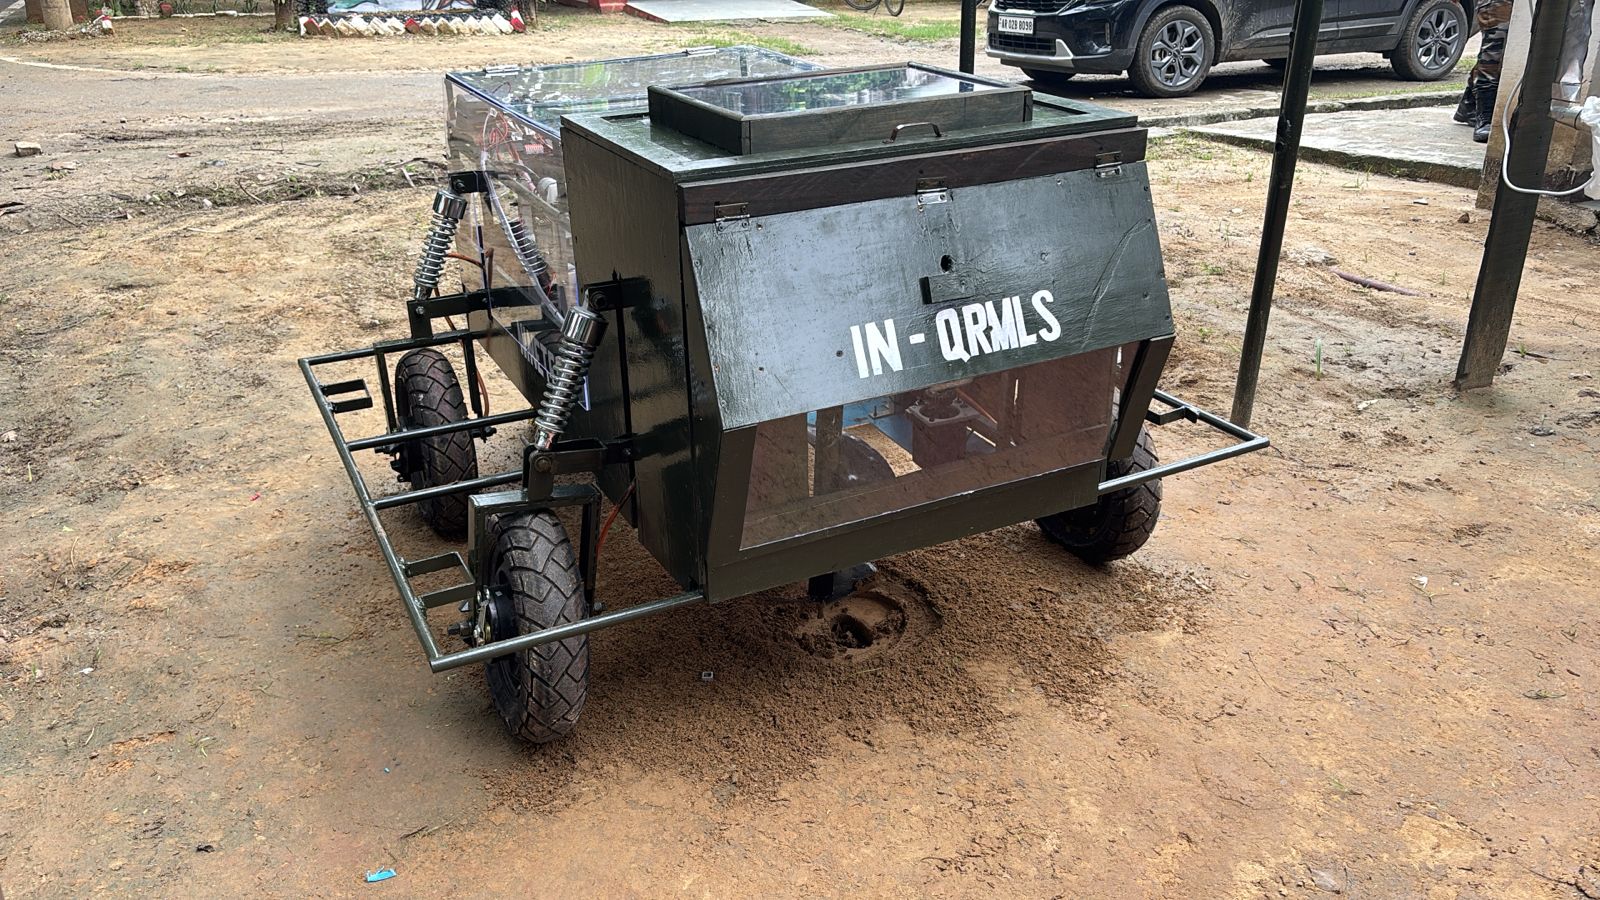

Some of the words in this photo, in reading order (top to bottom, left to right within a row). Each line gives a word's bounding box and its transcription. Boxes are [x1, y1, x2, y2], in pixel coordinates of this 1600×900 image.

[850, 319, 903, 379] IN
[909, 333, 925, 344] -
[935, 289, 1061, 363] QRMLS
